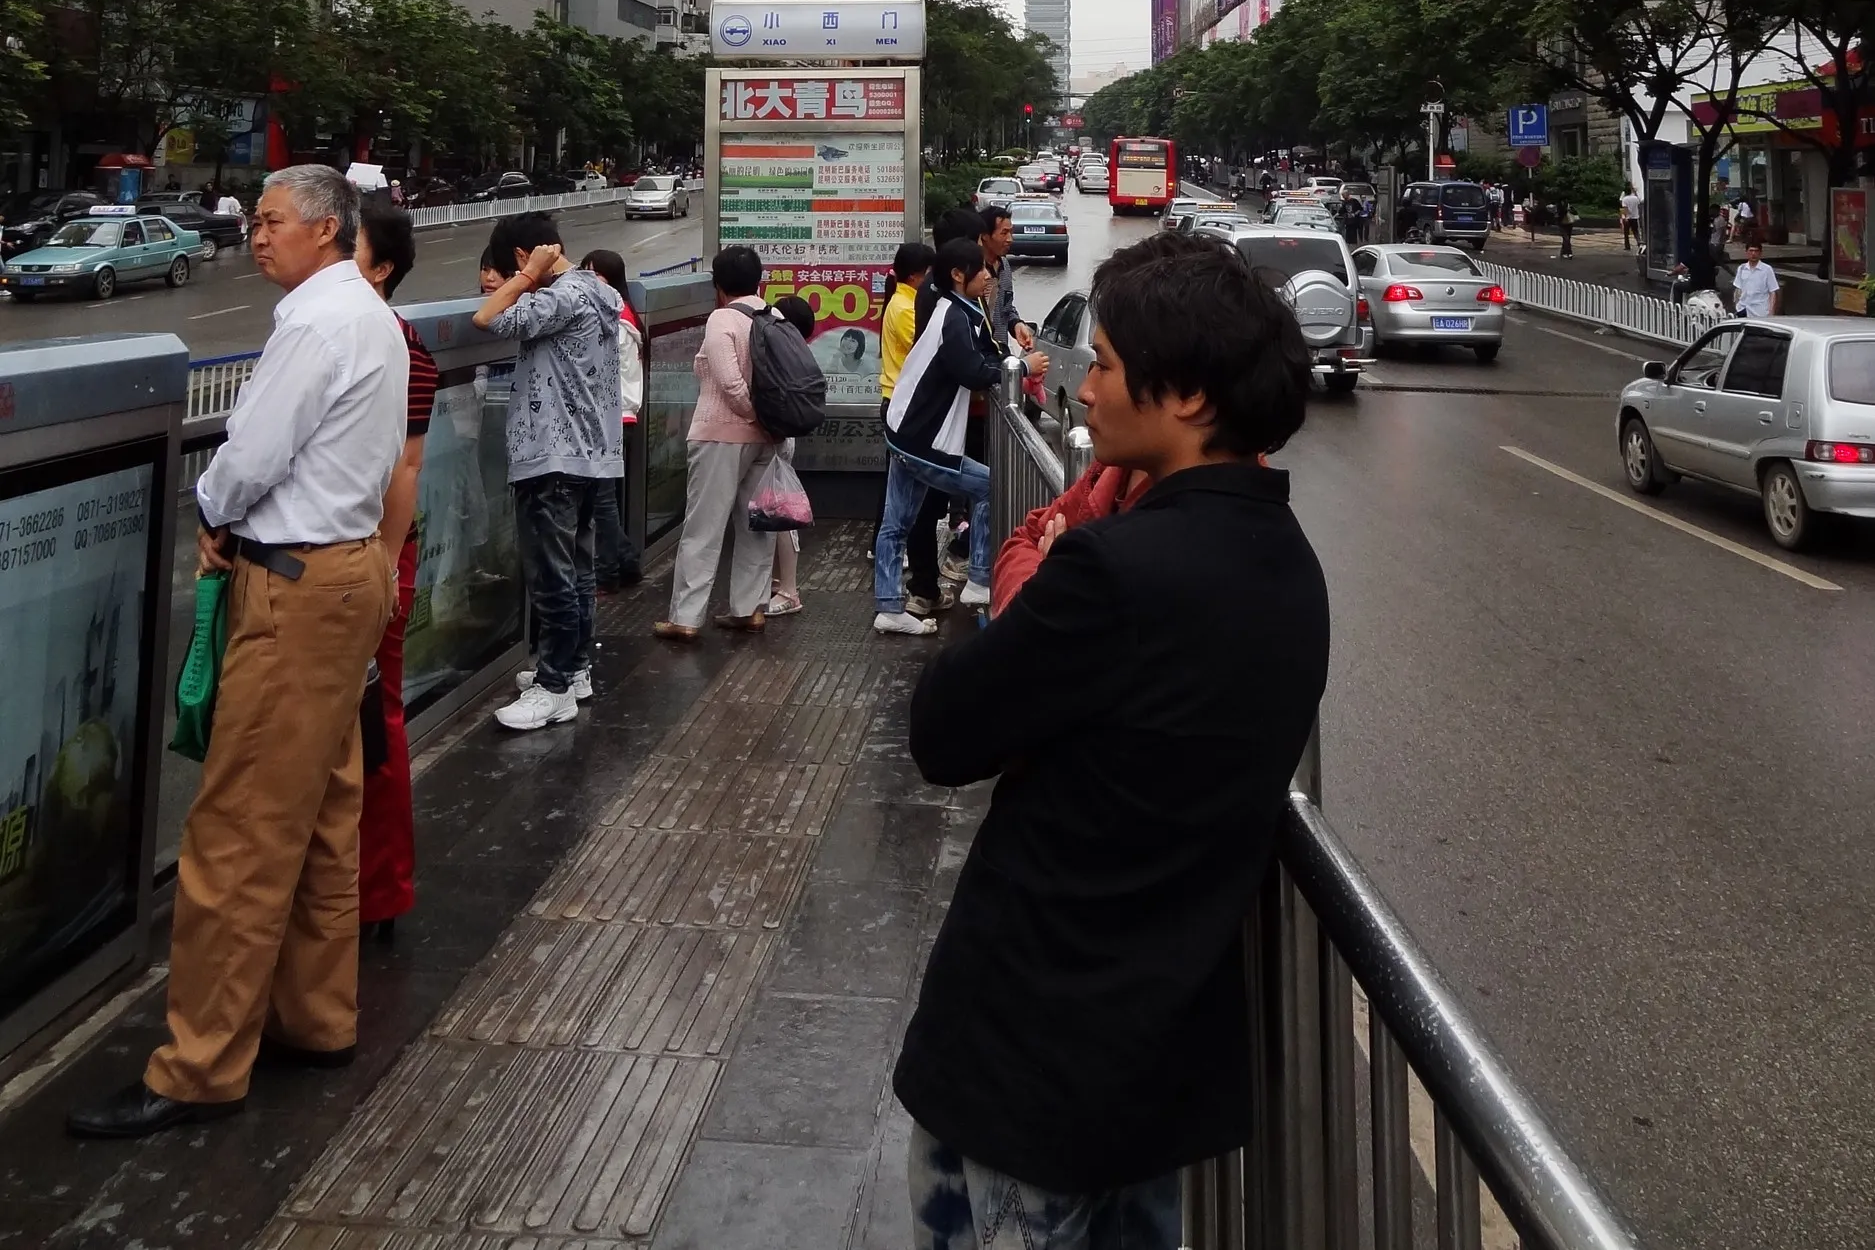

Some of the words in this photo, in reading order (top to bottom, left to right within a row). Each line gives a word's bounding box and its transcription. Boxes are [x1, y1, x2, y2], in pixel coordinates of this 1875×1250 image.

[763, 11, 898, 30] 小西门
[762, 38, 787, 46] XIAO
[826, 38, 836, 46] XI
[721, 81, 867, 119] 北大青鸟
[1518, 109, 1538, 134] P
[817, 175, 871, 184] 昆明公交服务电话
[816, 229, 870, 238] 昆明公交服务电话
[797, 270, 869, 282] 安全保宫手术
